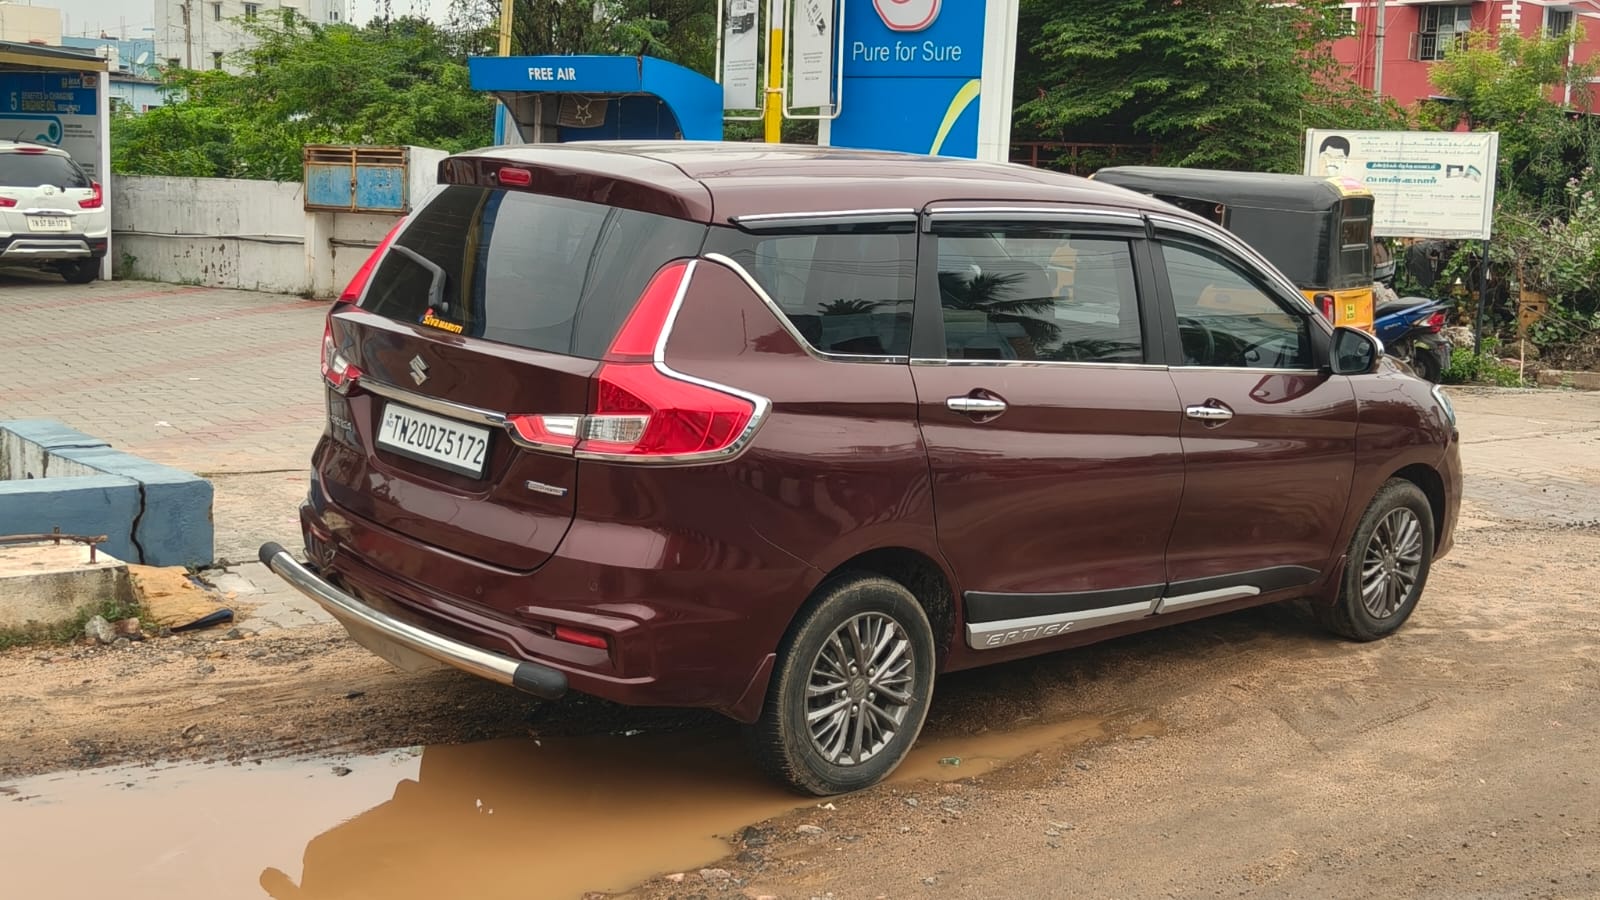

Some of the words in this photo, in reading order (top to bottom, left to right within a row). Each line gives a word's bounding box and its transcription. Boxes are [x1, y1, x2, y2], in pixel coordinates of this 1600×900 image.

[853, 41, 890, 61] Pure
[895, 41, 917, 61] for
[922, 40, 962, 62] Sure
[528, 67, 554, 81] FREE
[557, 67, 576, 81] AIR
[10, 91, 18, 111] 5
[22, 100, 45, 111] ENGINE
[46, 101, 57, 112] OIL
[392, 414, 486, 465] TN20DZ5172
[986, 621, 1075, 646] ERTIGA
